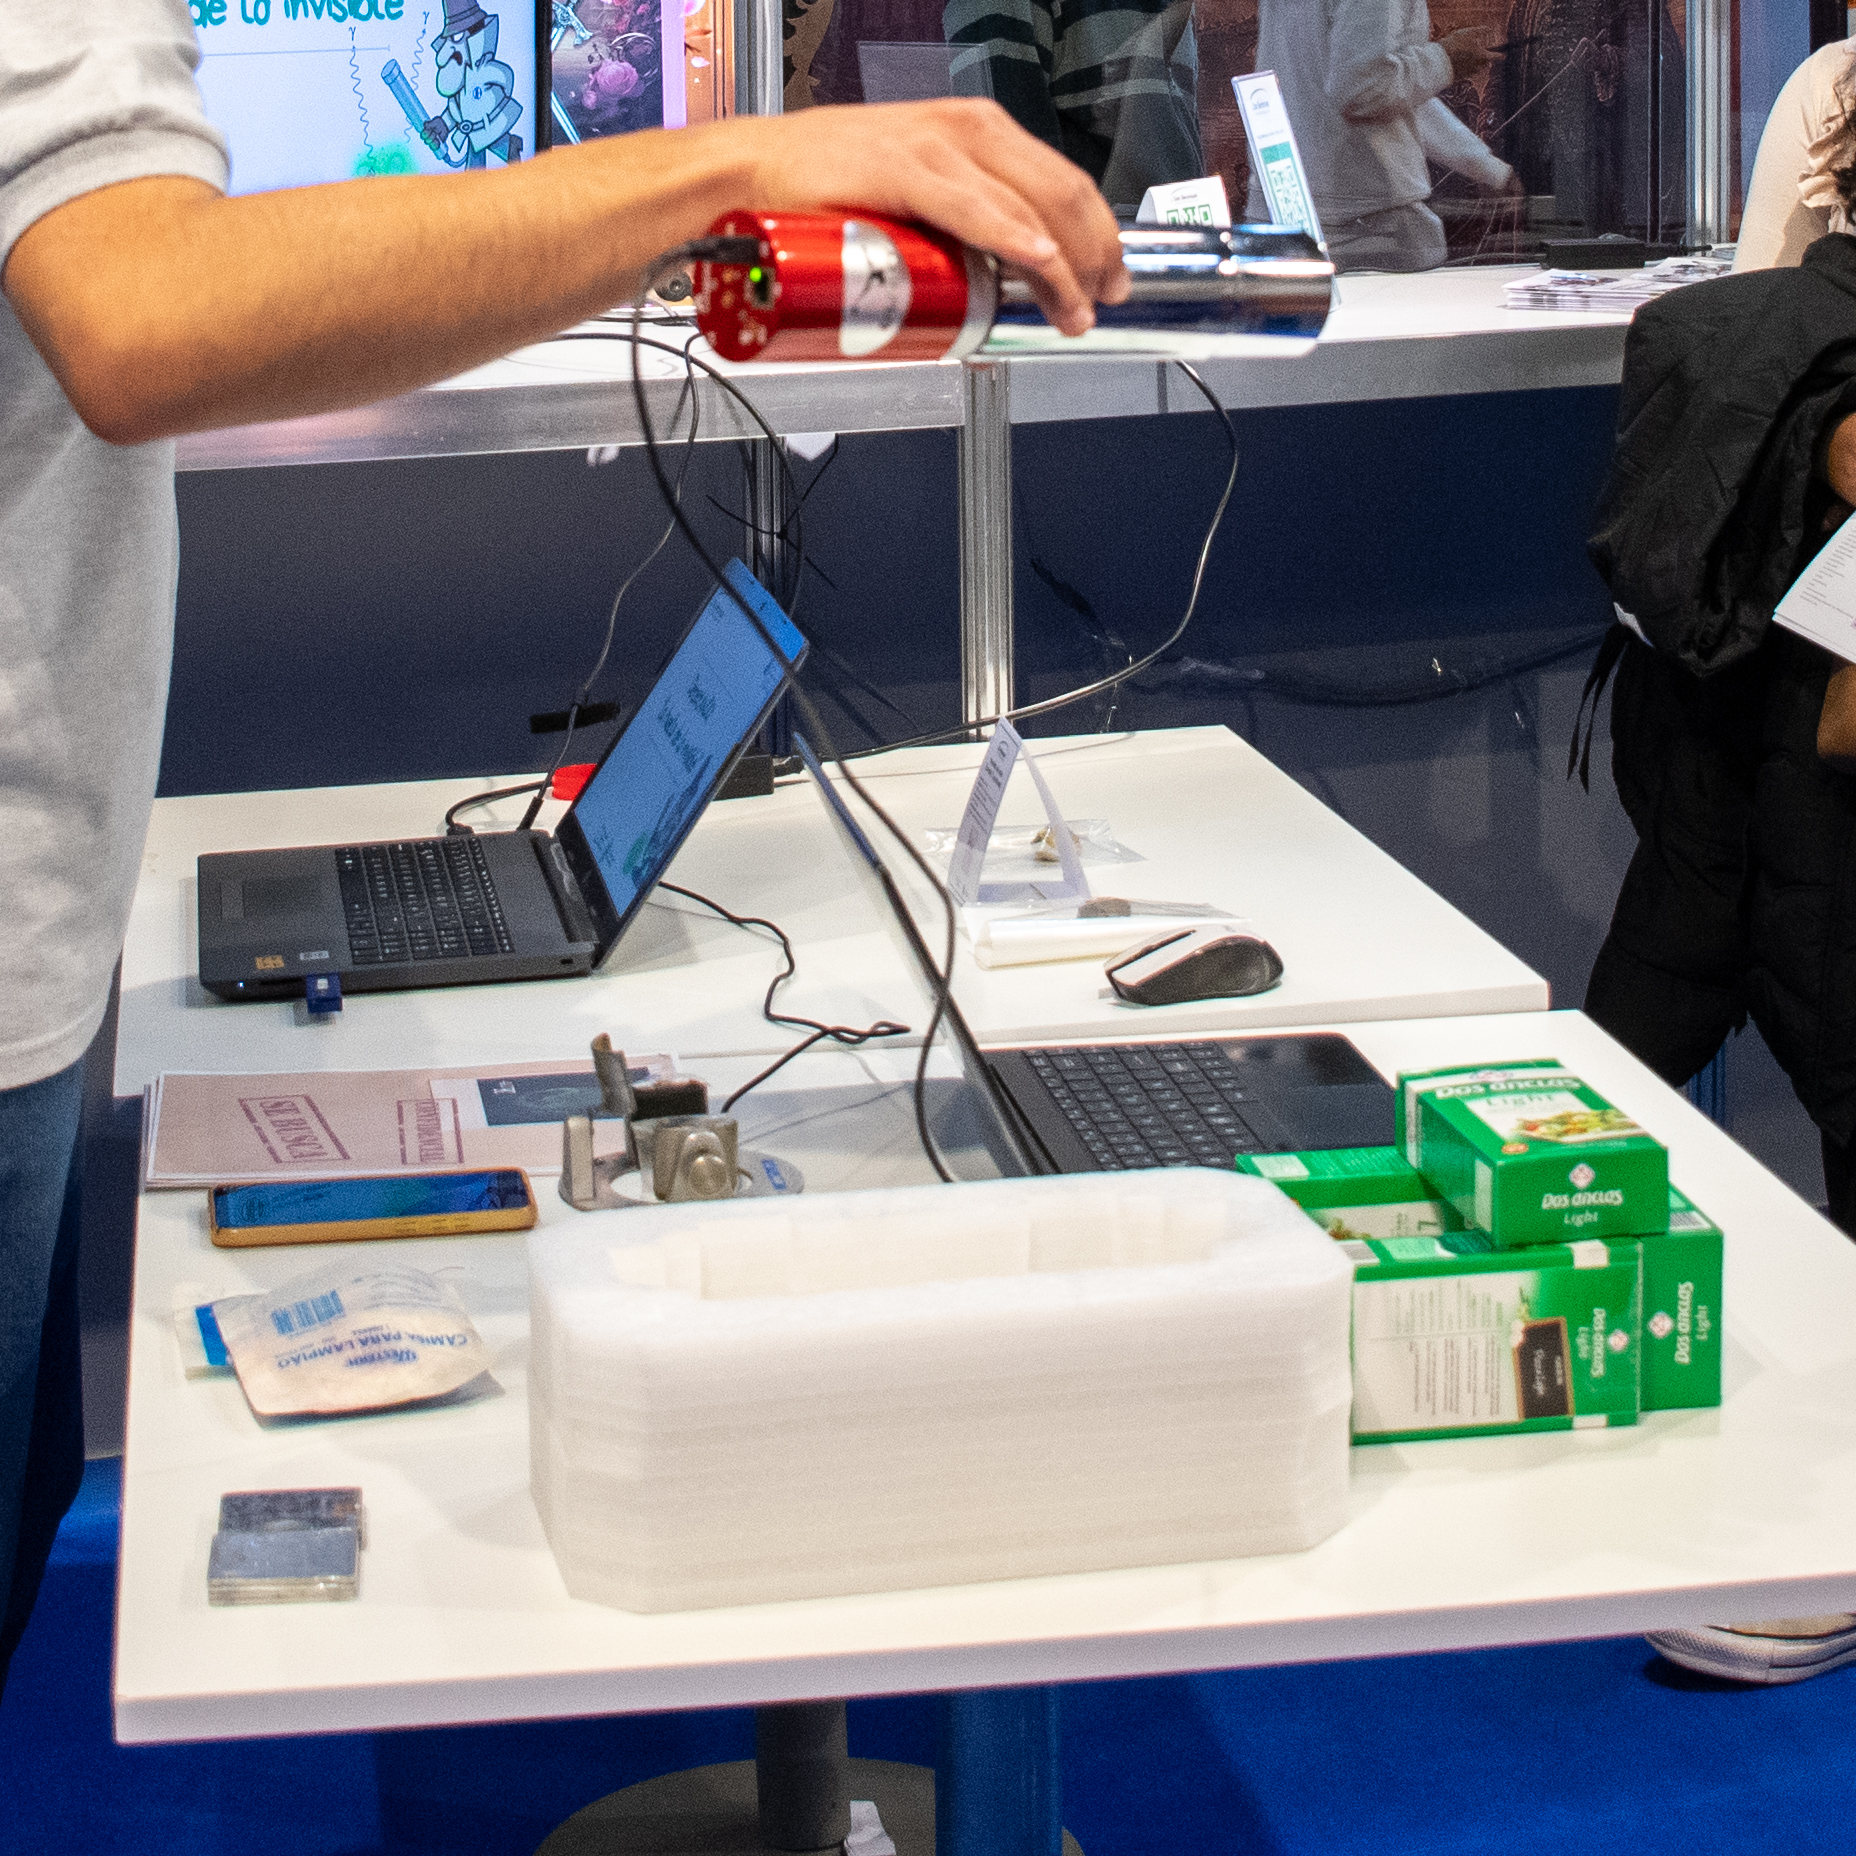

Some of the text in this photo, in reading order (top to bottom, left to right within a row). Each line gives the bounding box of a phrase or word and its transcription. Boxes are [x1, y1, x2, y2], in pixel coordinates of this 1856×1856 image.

[1434, 1085, 1486, 1100] Dos
[259, 1100, 329, 1160] SE BUSCA
[1541, 1189, 1624, 1211] Dos anclas
[1564, 1211, 1599, 1228] Light
[1694, 1304, 1712, 1342] Light
[357, 1330, 403, 1347] PARA
[1674, 1334, 1693, 1366] Dos
